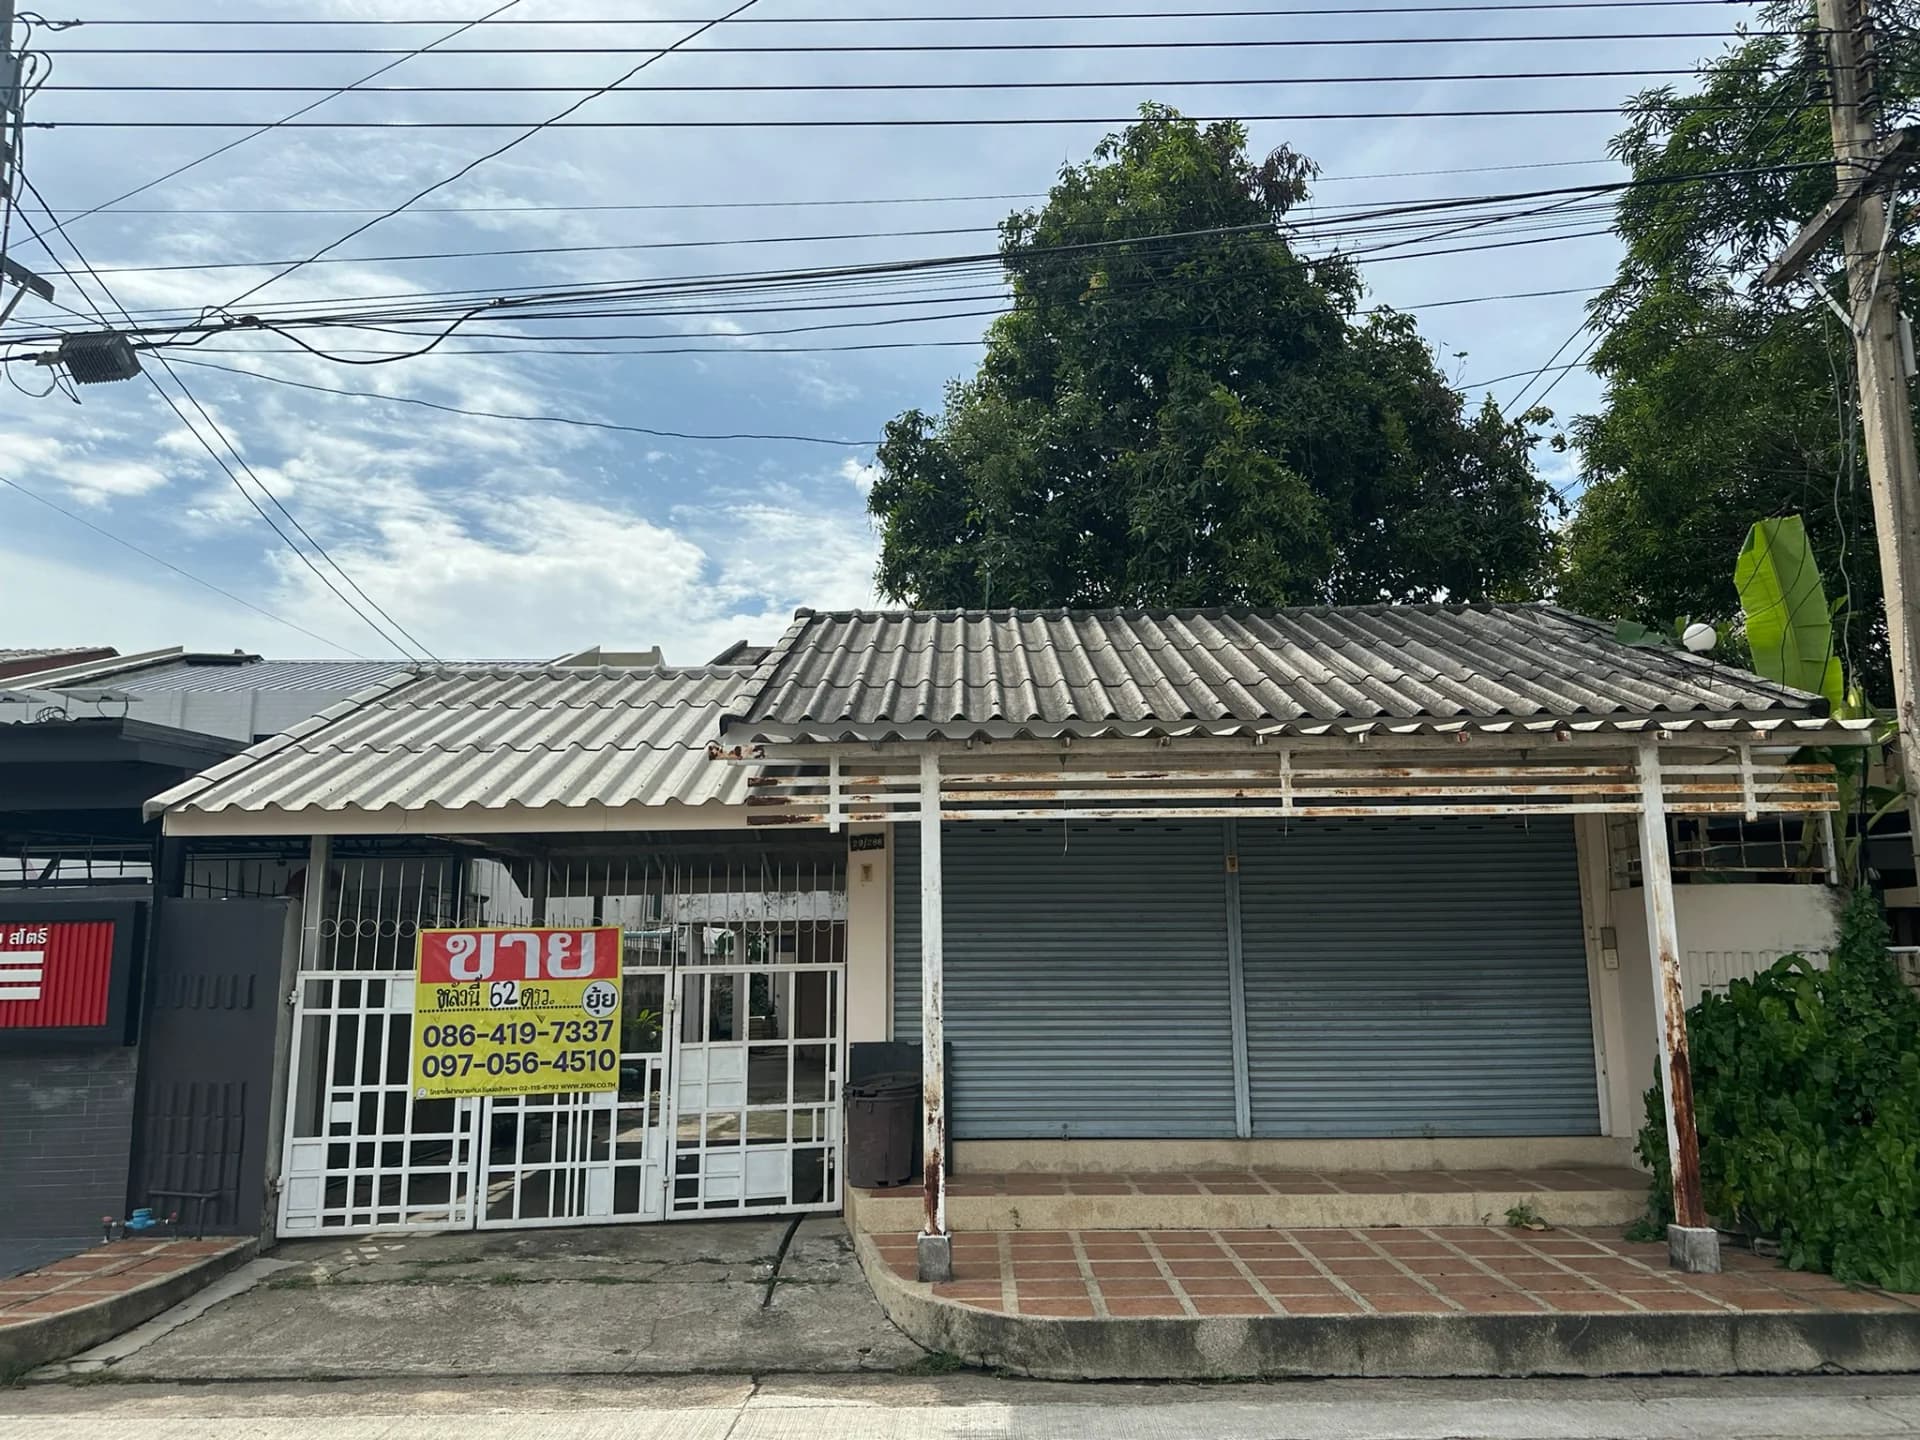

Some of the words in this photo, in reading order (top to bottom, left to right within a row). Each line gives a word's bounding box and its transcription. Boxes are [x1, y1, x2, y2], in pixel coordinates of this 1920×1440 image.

[446, 932, 596, 980] ขาย
[490, 981, 518, 1008] 62
[423, 1019, 615, 1048] 086-419-7337
[422, 1049, 616, 1078] 097-056-4510
